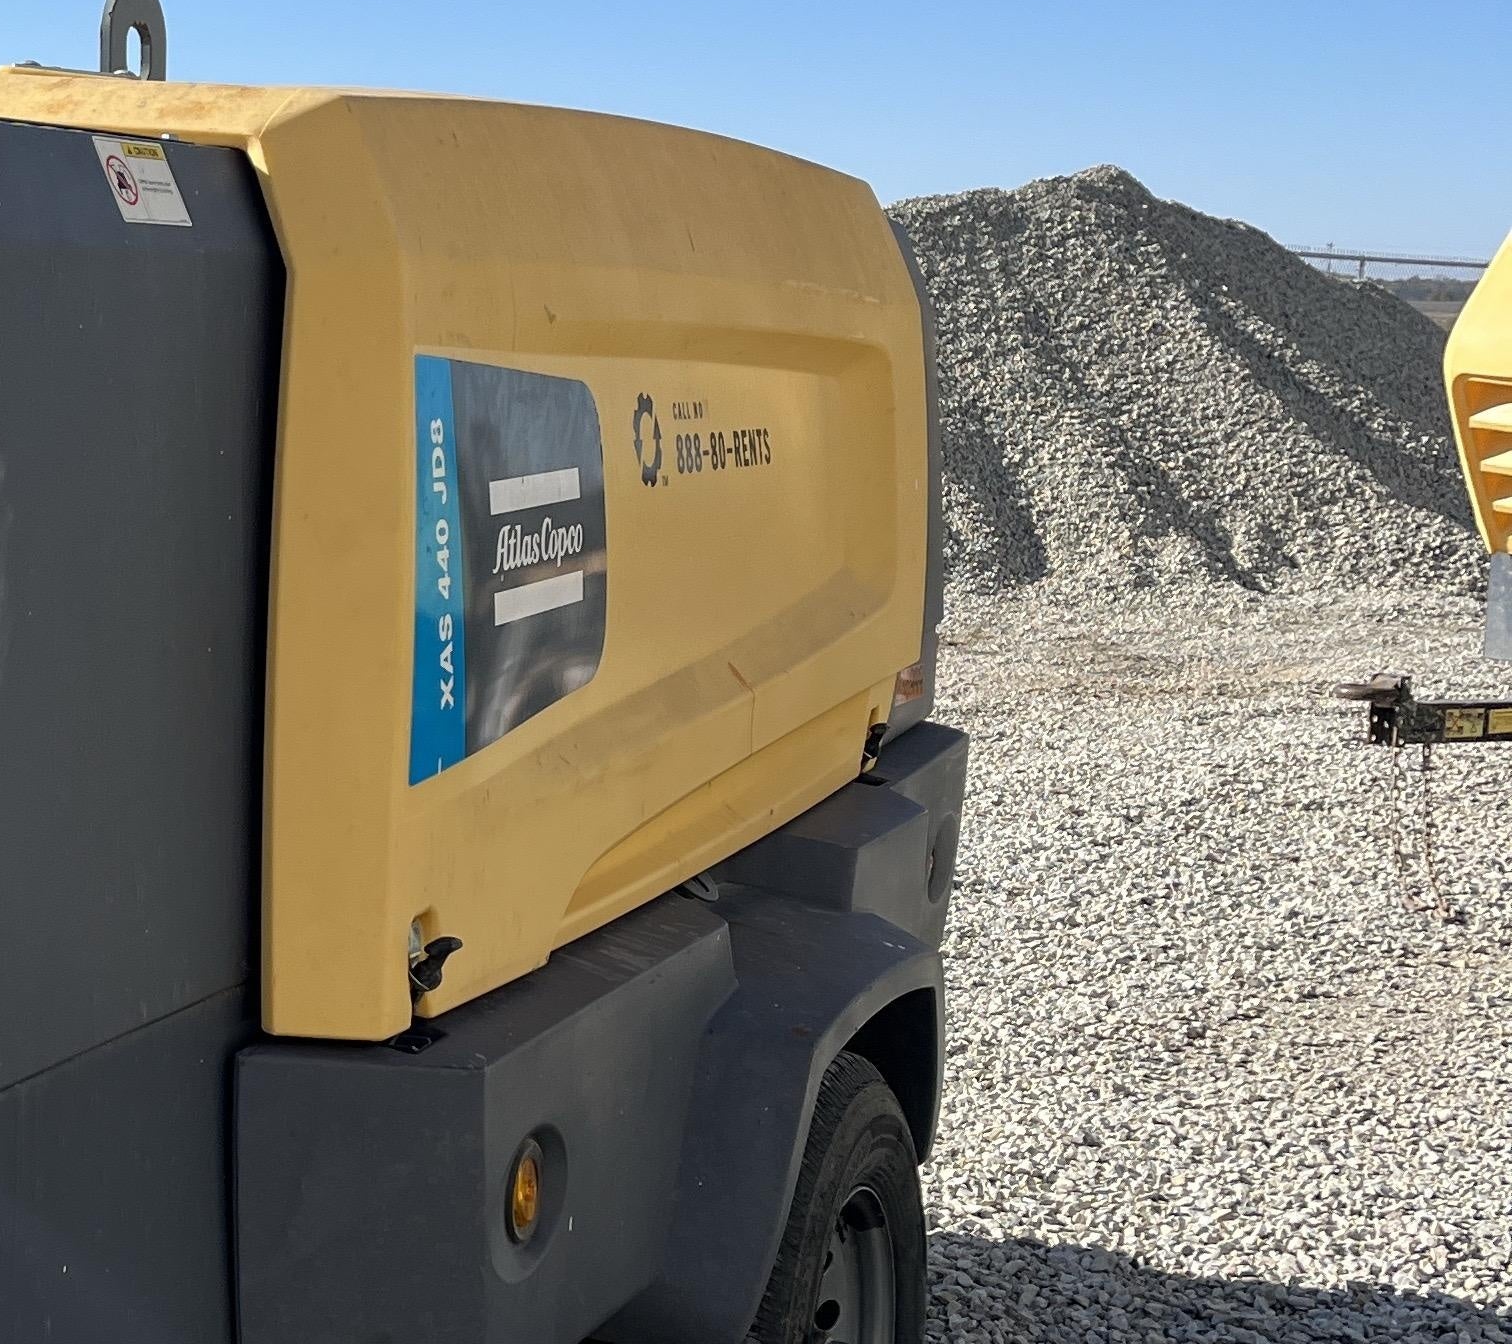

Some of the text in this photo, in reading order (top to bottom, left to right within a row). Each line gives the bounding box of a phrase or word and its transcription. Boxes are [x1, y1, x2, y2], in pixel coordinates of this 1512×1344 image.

[672, 401, 691, 420] CALL
[675, 428, 771, 474] 888-80-RENTS
[430, 417, 455, 711] XAS 440 JD8
[492, 517, 584, 574] Atlas Copco
